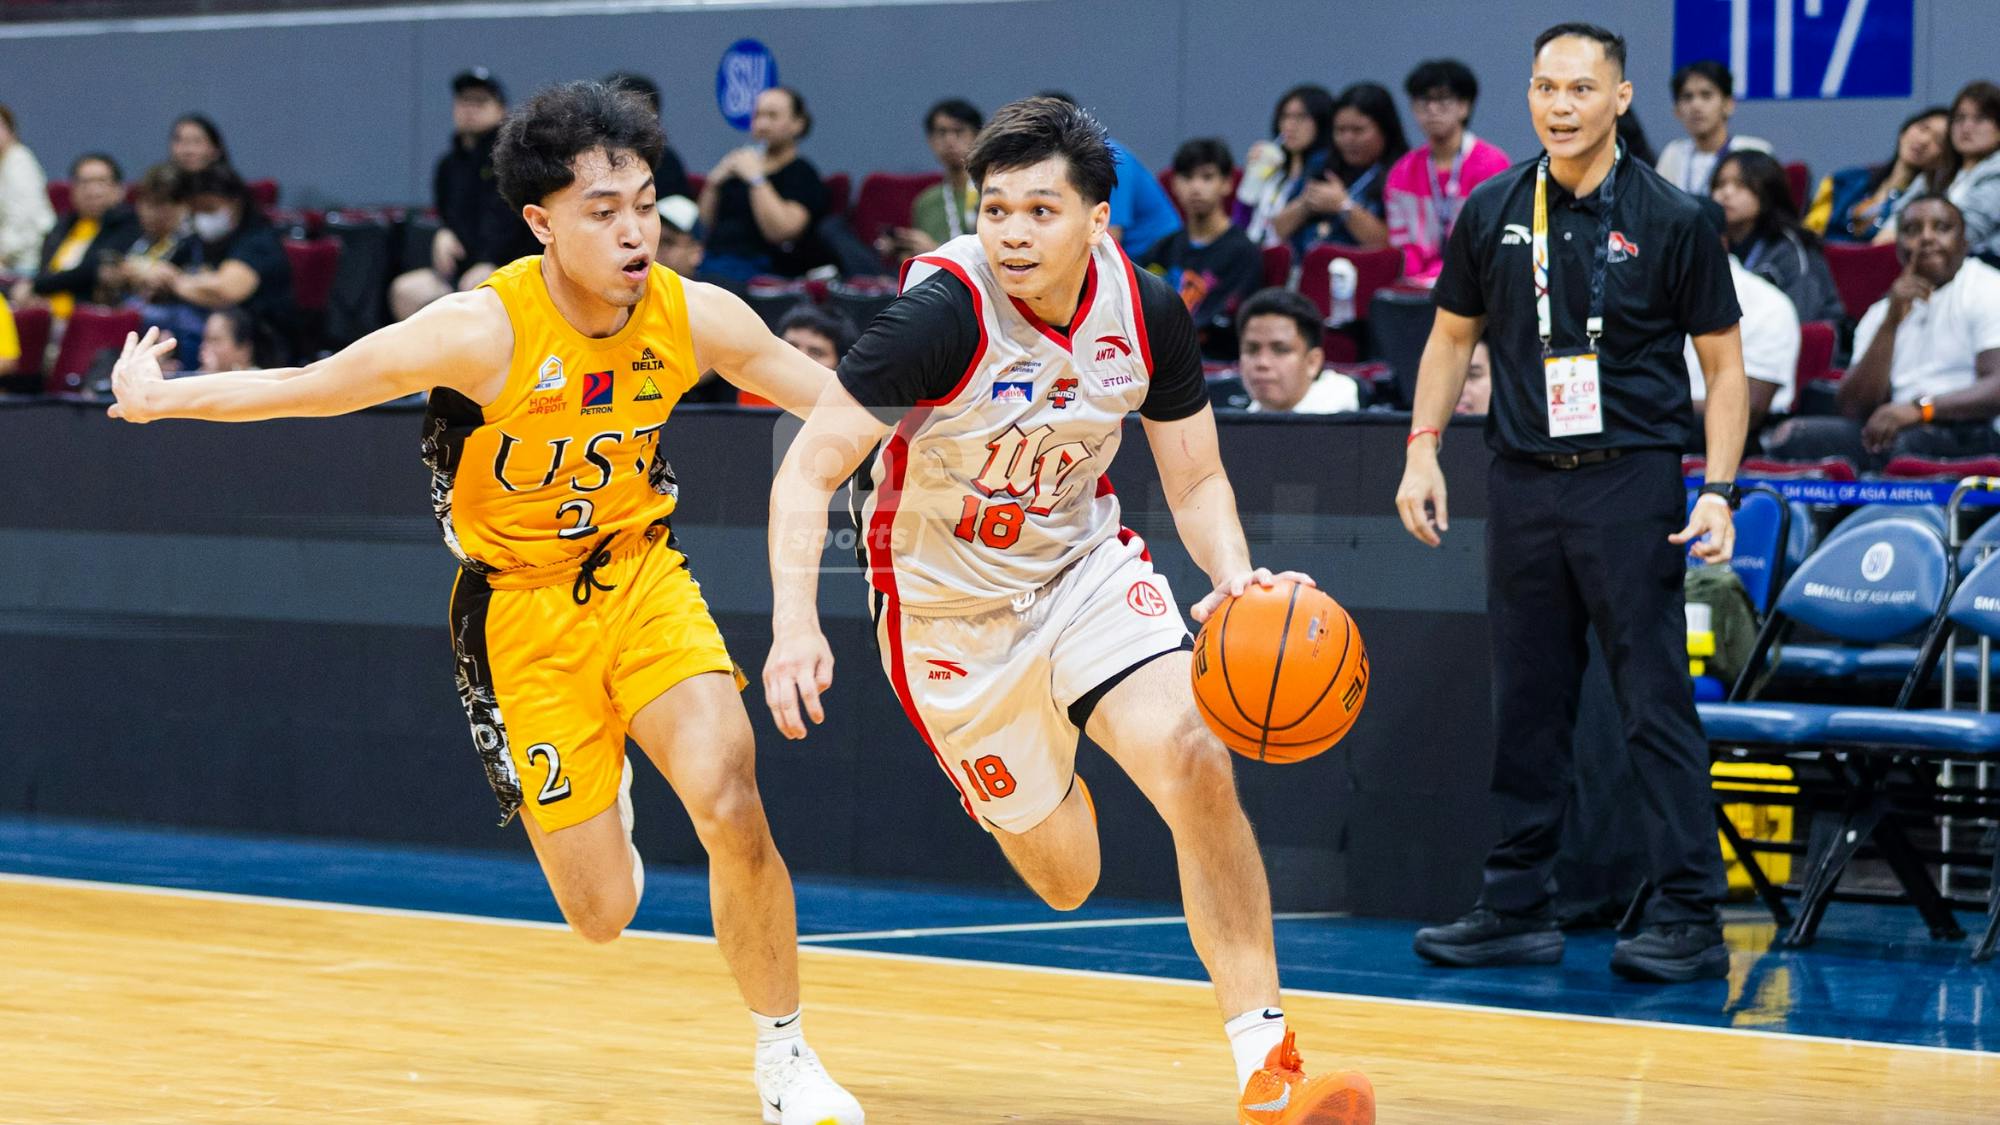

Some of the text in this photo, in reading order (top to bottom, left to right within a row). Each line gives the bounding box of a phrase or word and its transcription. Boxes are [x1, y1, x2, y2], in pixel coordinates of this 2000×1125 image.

[1095, 348, 1116, 362] ANTA
[632, 360, 665, 371] DELTA
[530, 393, 563, 408] HOME
[581, 406, 613, 416] PETRON
[494, 422, 667, 493] UST
[1782, 485, 1933, 500] SM MALL OF ASIA ARENA
[555, 498, 598, 539] 2
[954, 494, 1026, 549] 18
[928, 671, 951, 680] ANTA
[526, 742, 571, 805] 2
[961, 754, 1017, 802] 18
